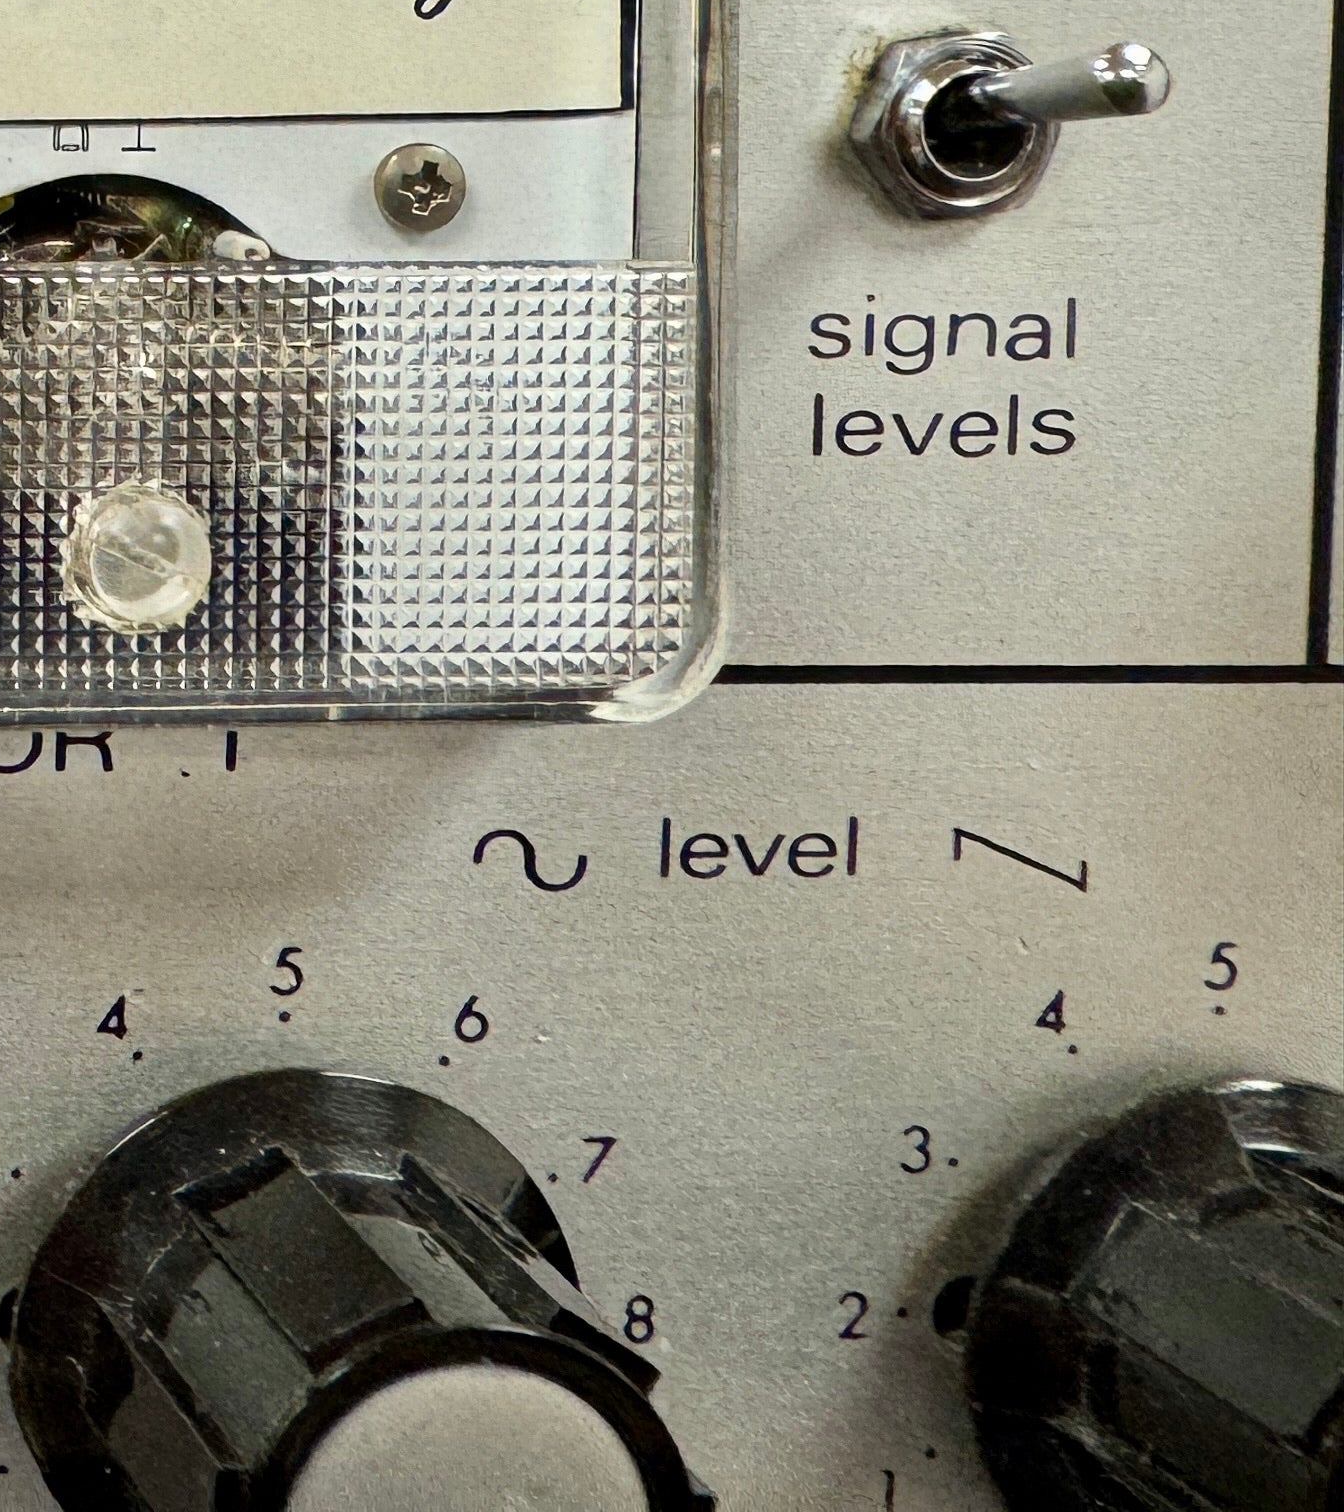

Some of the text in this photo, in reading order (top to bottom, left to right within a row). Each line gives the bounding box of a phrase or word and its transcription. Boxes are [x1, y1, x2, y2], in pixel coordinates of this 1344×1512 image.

[807, 294, 1077, 376] signal
[812, 392, 1077, 458] levels
[659, 815, 859, 880] level
[96, 994, 129, 1040] 4
[269, 946, 304, 997] 5
[454, 994, 490, 1044] 6
[581, 1136, 618, 1184] 7
[623, 1294, 655, 1345] 8
[838, 1290, 870, 1341] 2
[900, 1124, 932, 1175] 3
[1034, 989, 1066, 1034] 4
[1203, 942, 1238, 991] 5
